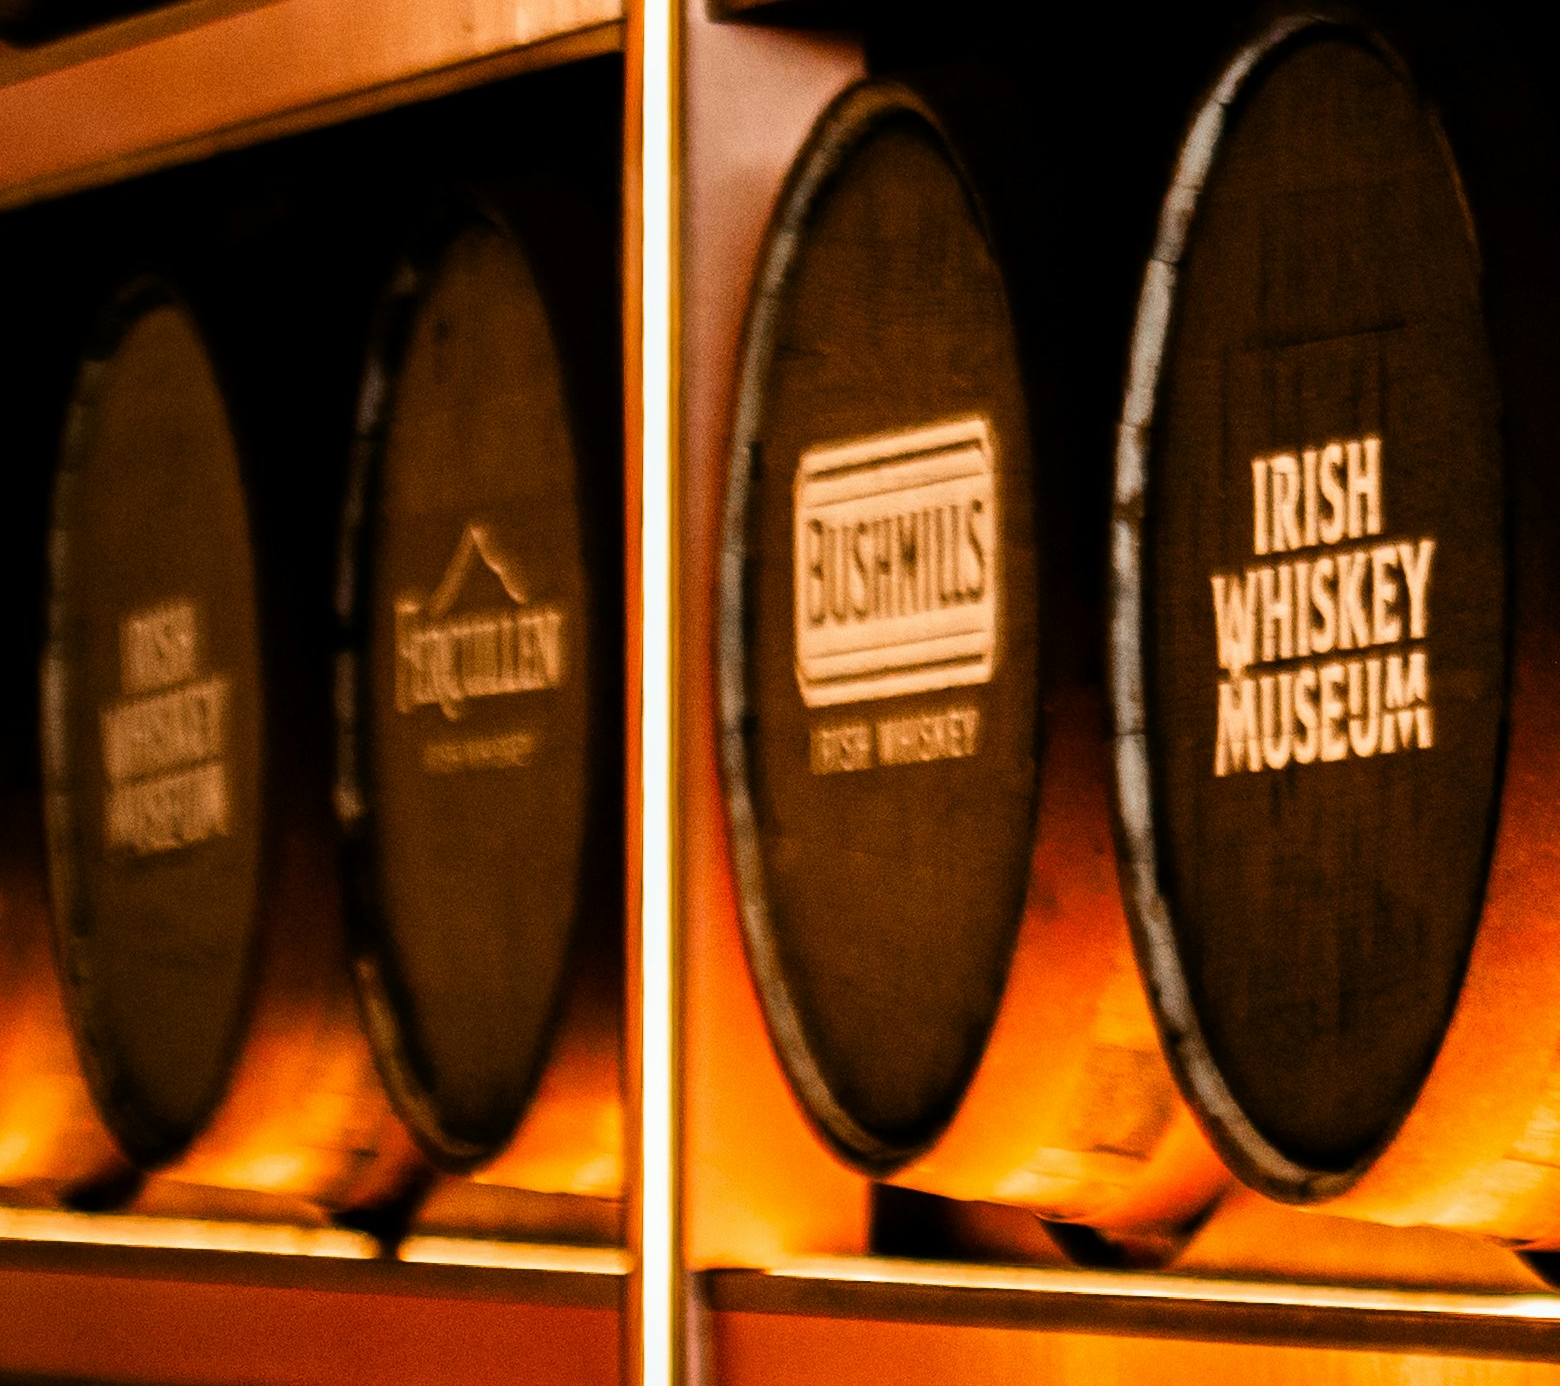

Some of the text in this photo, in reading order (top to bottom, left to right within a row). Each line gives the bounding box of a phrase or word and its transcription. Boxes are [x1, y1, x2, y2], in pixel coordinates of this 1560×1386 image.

[1252, 436, 1383, 556] IRISH
[807, 499, 986, 627] BUSHMILLS
[1212, 540, 1436, 674] WHISKEY
[876, 707, 980, 766] WHISKEY
[1216, 654, 1432, 778] MUSEUM
